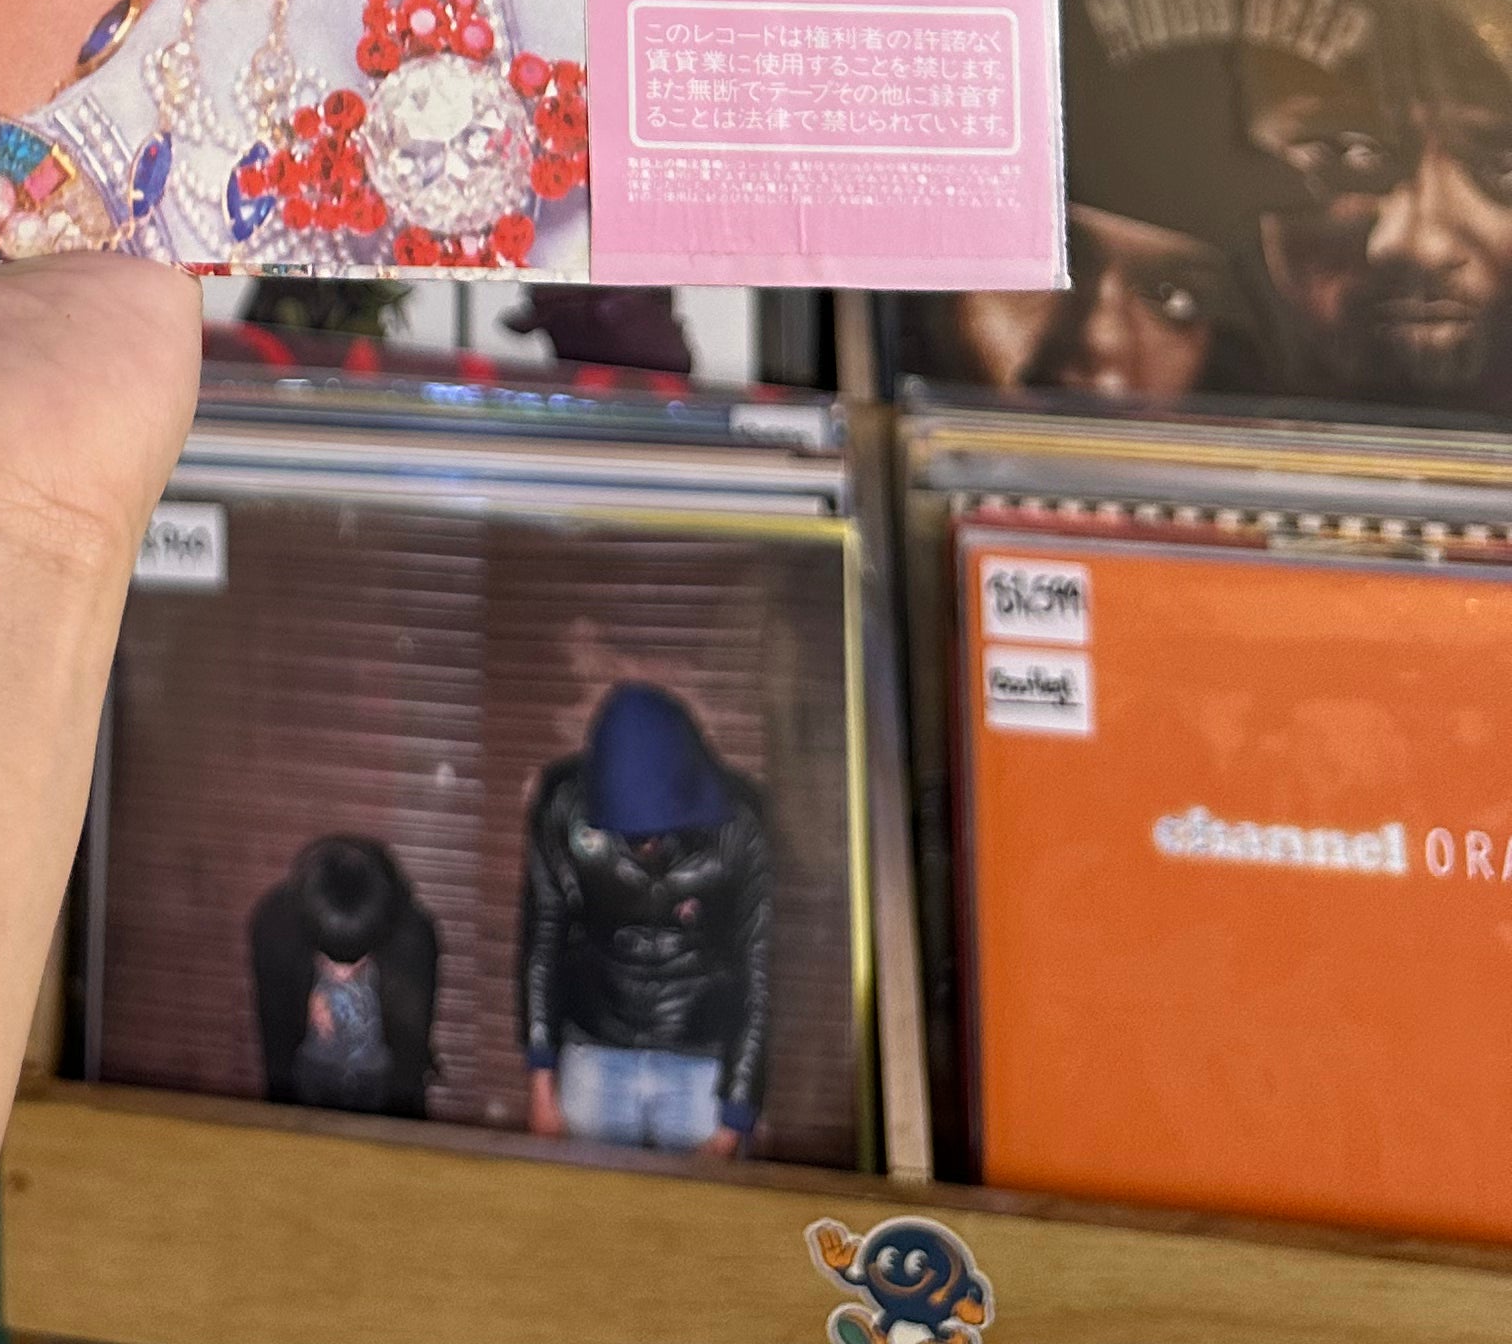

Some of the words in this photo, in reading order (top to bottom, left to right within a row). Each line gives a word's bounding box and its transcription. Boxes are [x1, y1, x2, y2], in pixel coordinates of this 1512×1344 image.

[644, 22, 1002, 53] このレコードは権利者の許諾なく
[644, 48, 1006, 81] 賃貸業に使用することを禁じます。
[645, 77, 1004, 108] また無断でテープその他に録音す
[647, 105, 1009, 138] ることは法律で禁じられています。
[1153, 805, 1408, 876] channel
